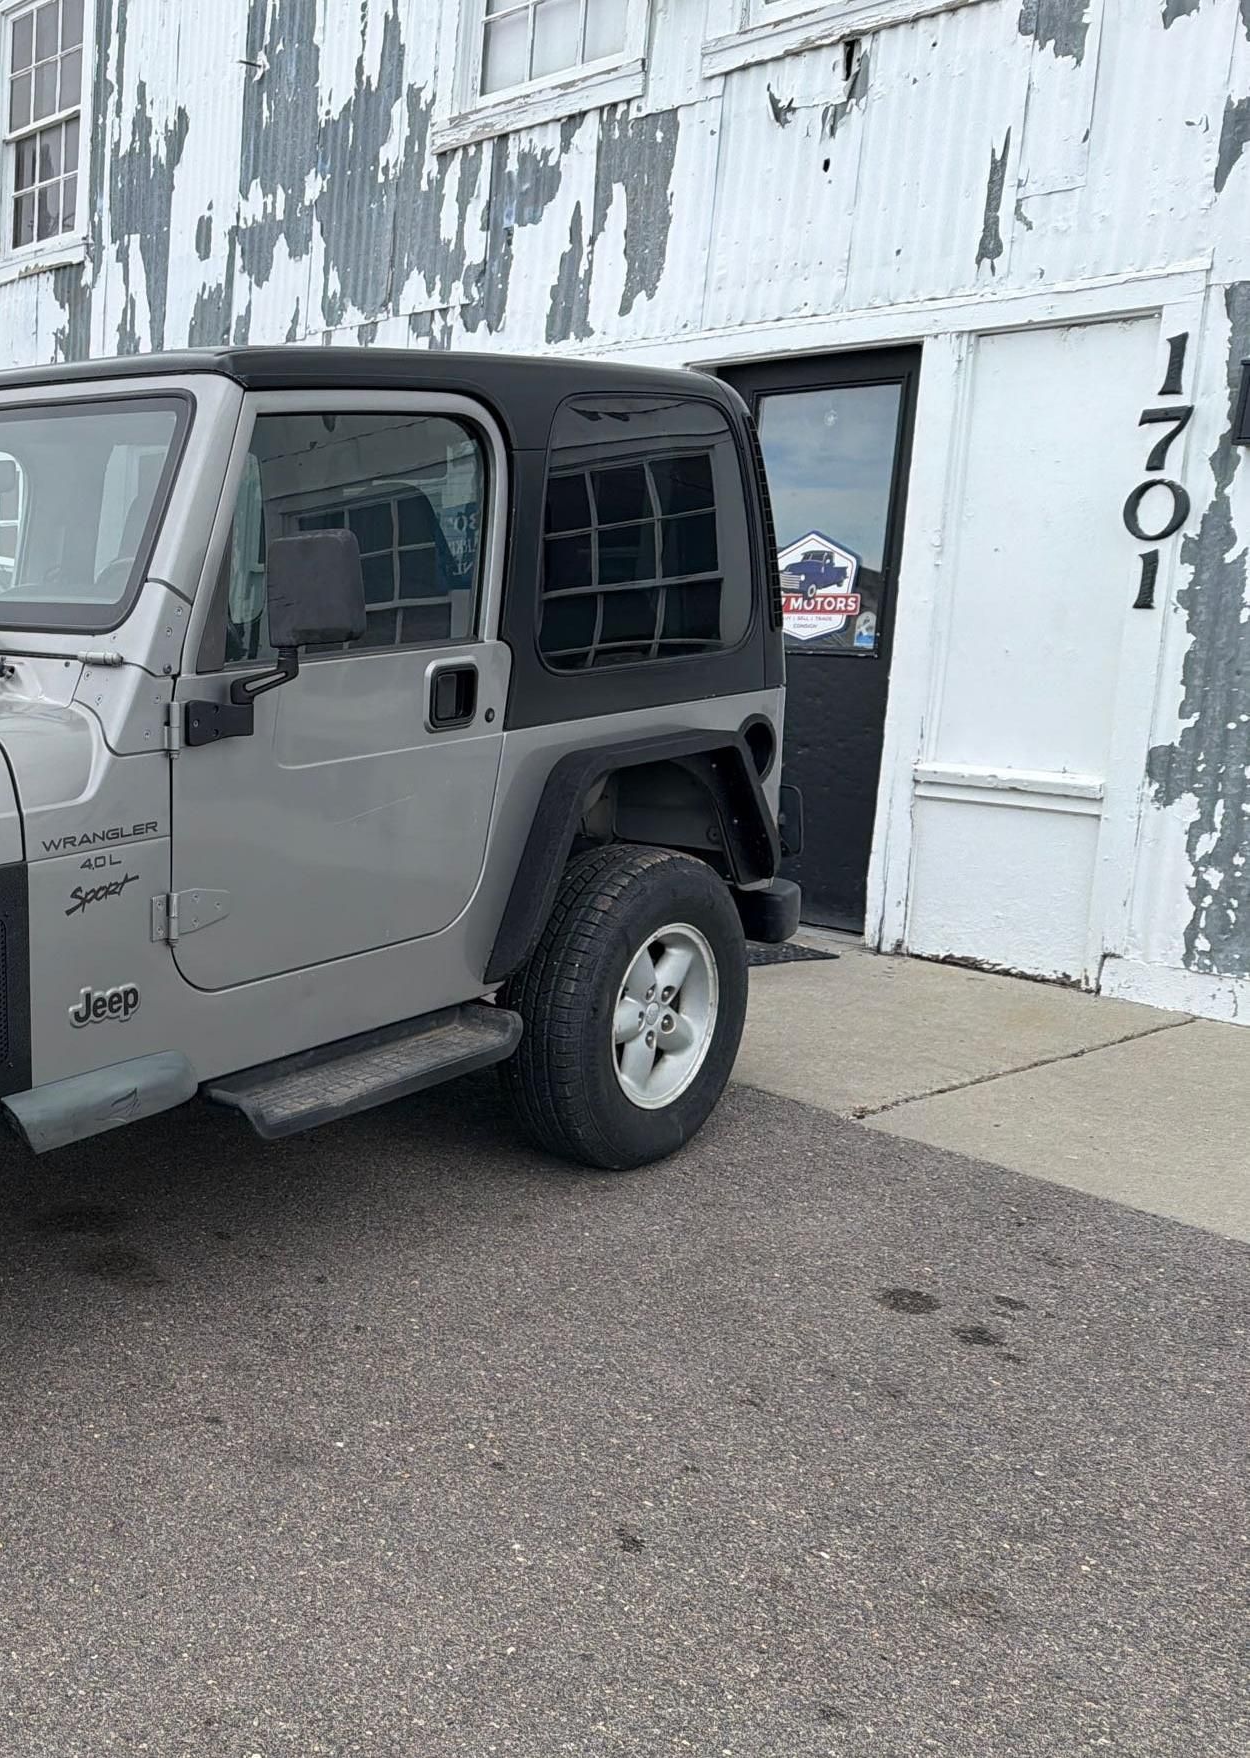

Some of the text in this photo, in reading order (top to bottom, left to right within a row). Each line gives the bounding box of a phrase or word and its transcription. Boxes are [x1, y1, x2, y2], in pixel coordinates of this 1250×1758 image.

[1123, 332, 1194, 609] 1701
[789, 597, 856, 611] MOTORS
[42, 821, 158, 852] WRANGLER
[71, 985, 140, 1025] Jeep
